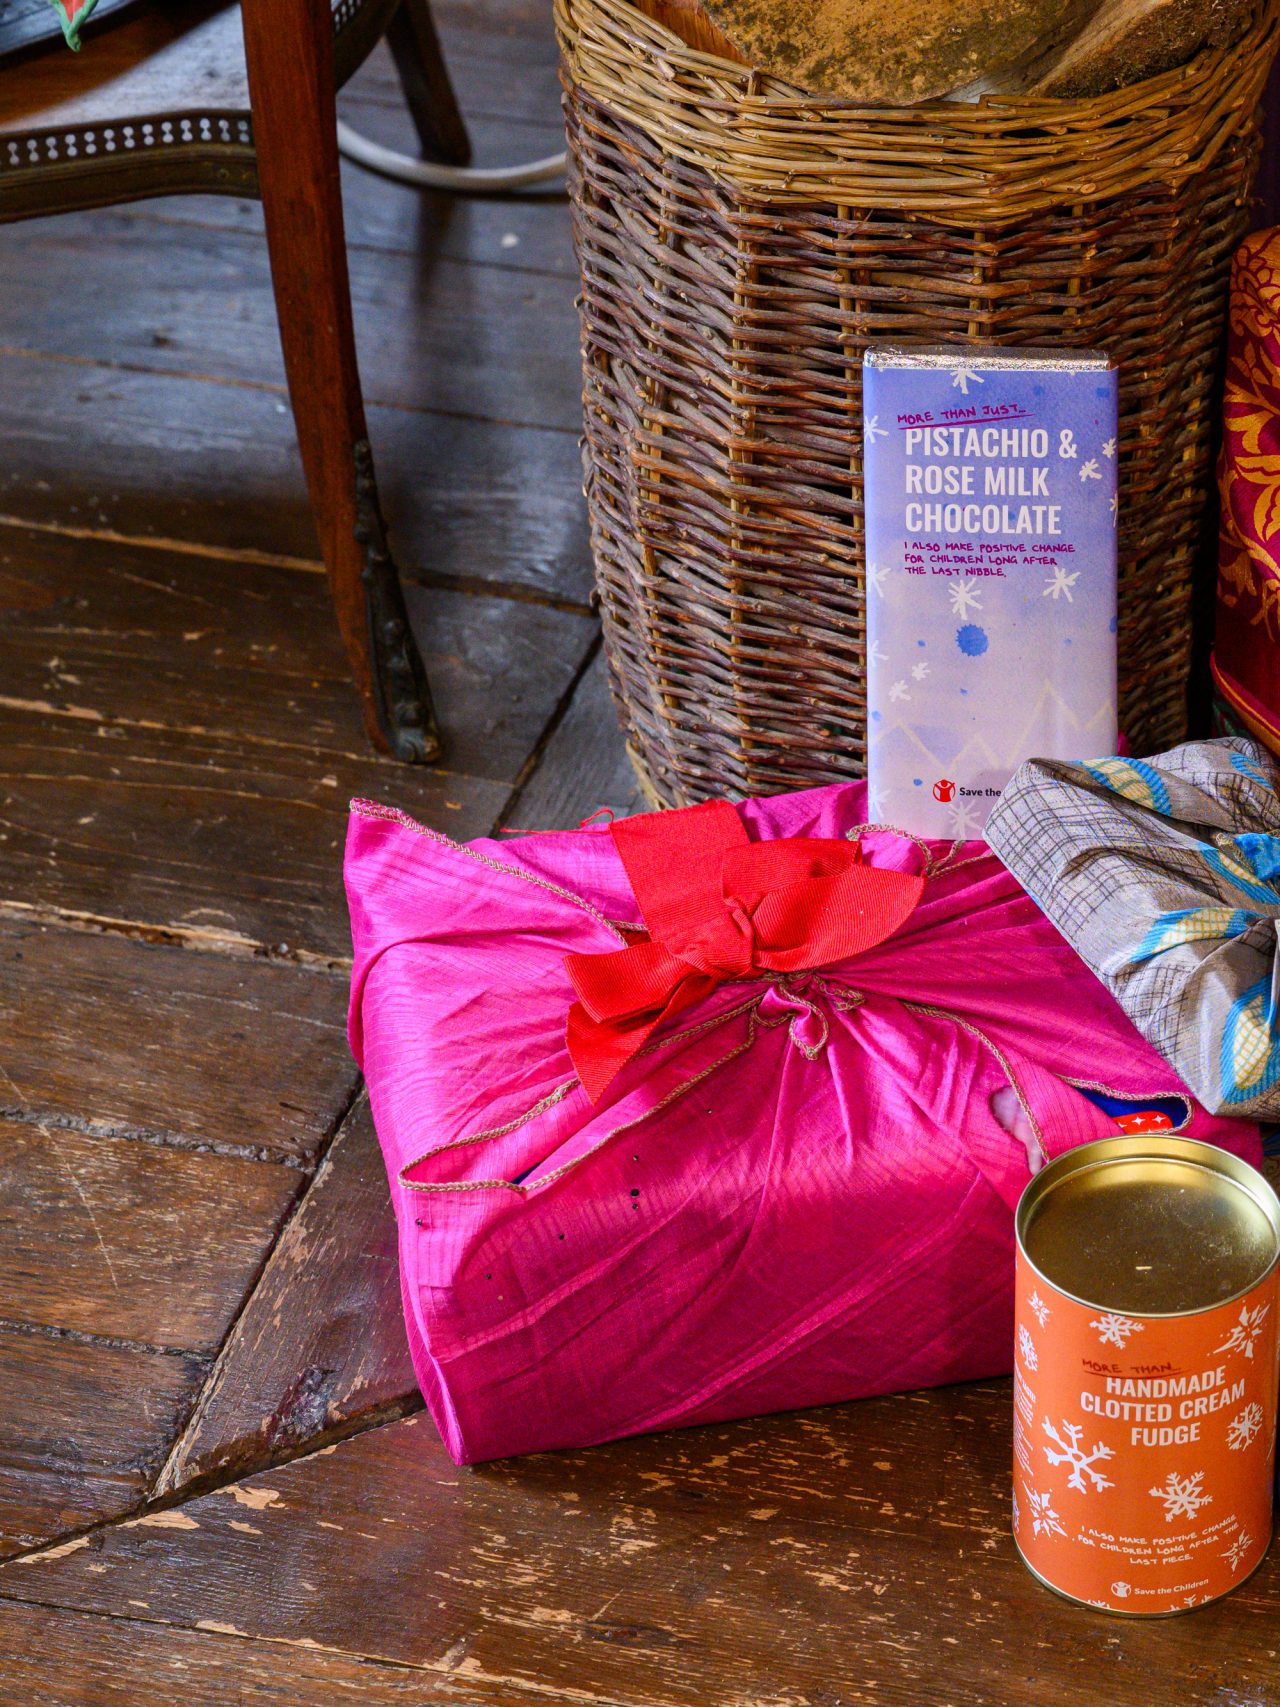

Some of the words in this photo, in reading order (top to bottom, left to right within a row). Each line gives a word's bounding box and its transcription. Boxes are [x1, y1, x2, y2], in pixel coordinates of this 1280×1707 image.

[897, 411, 934, 425] MORE
[940, 406, 976, 419] THAN
[905, 427, 1049, 458] PISTACHIO
[1059, 429, 1077, 458] &
[905, 465, 975, 495] ROSE
[984, 466, 1049, 496] MILK
[905, 503, 1061, 534] CHOCOLATE
[904, 541, 907, 550] I
[912, 542, 940, 552] ALSO
[945, 543, 974, 551] MAKE
[980, 544, 1027, 553] POSITIVE
[1032, 544, 1075, 552] CHANGE
[904, 553, 924, 563] FOR
[930, 555, 984, 564] CHILDREN
[989, 556, 1018, 566] LONG
[1023, 556, 1057, 565] AFTER
[932, 567, 960, 576] LAST
[965, 567, 1007, 577] NIBBLE.
[959, 787, 983, 796] Save
[985, 788, 1001, 797] the
[1082, 1358, 1122, 1373] MORE
[1106, 1365, 1227, 1398] HANDMADE
[1080, 1392, 1172, 1422] CLOTTED
[1179, 1378, 1245, 1420] CREAM
[1131, 1422, 1201, 1447] FUDGE
[1077, 1534, 1096, 1547] FOR
[1100, 1542, 1152, 1555] CHILDREN
[1157, 1545, 1185, 1555] LONG
[1189, 1535, 1219, 1549] AFTER
[1223, 1522, 1239, 1535] THE
[1088, 1528, 1115, 1542] ALSO
[1119, 1536, 1148, 1545] MAKE
[1152, 1532, 1197, 1546] POSITIVE
[1202, 1514, 1237, 1535] CHANGE
[1130, 1557, 1157, 1565] LAST
[1173, 1578, 1209, 1592] Children
